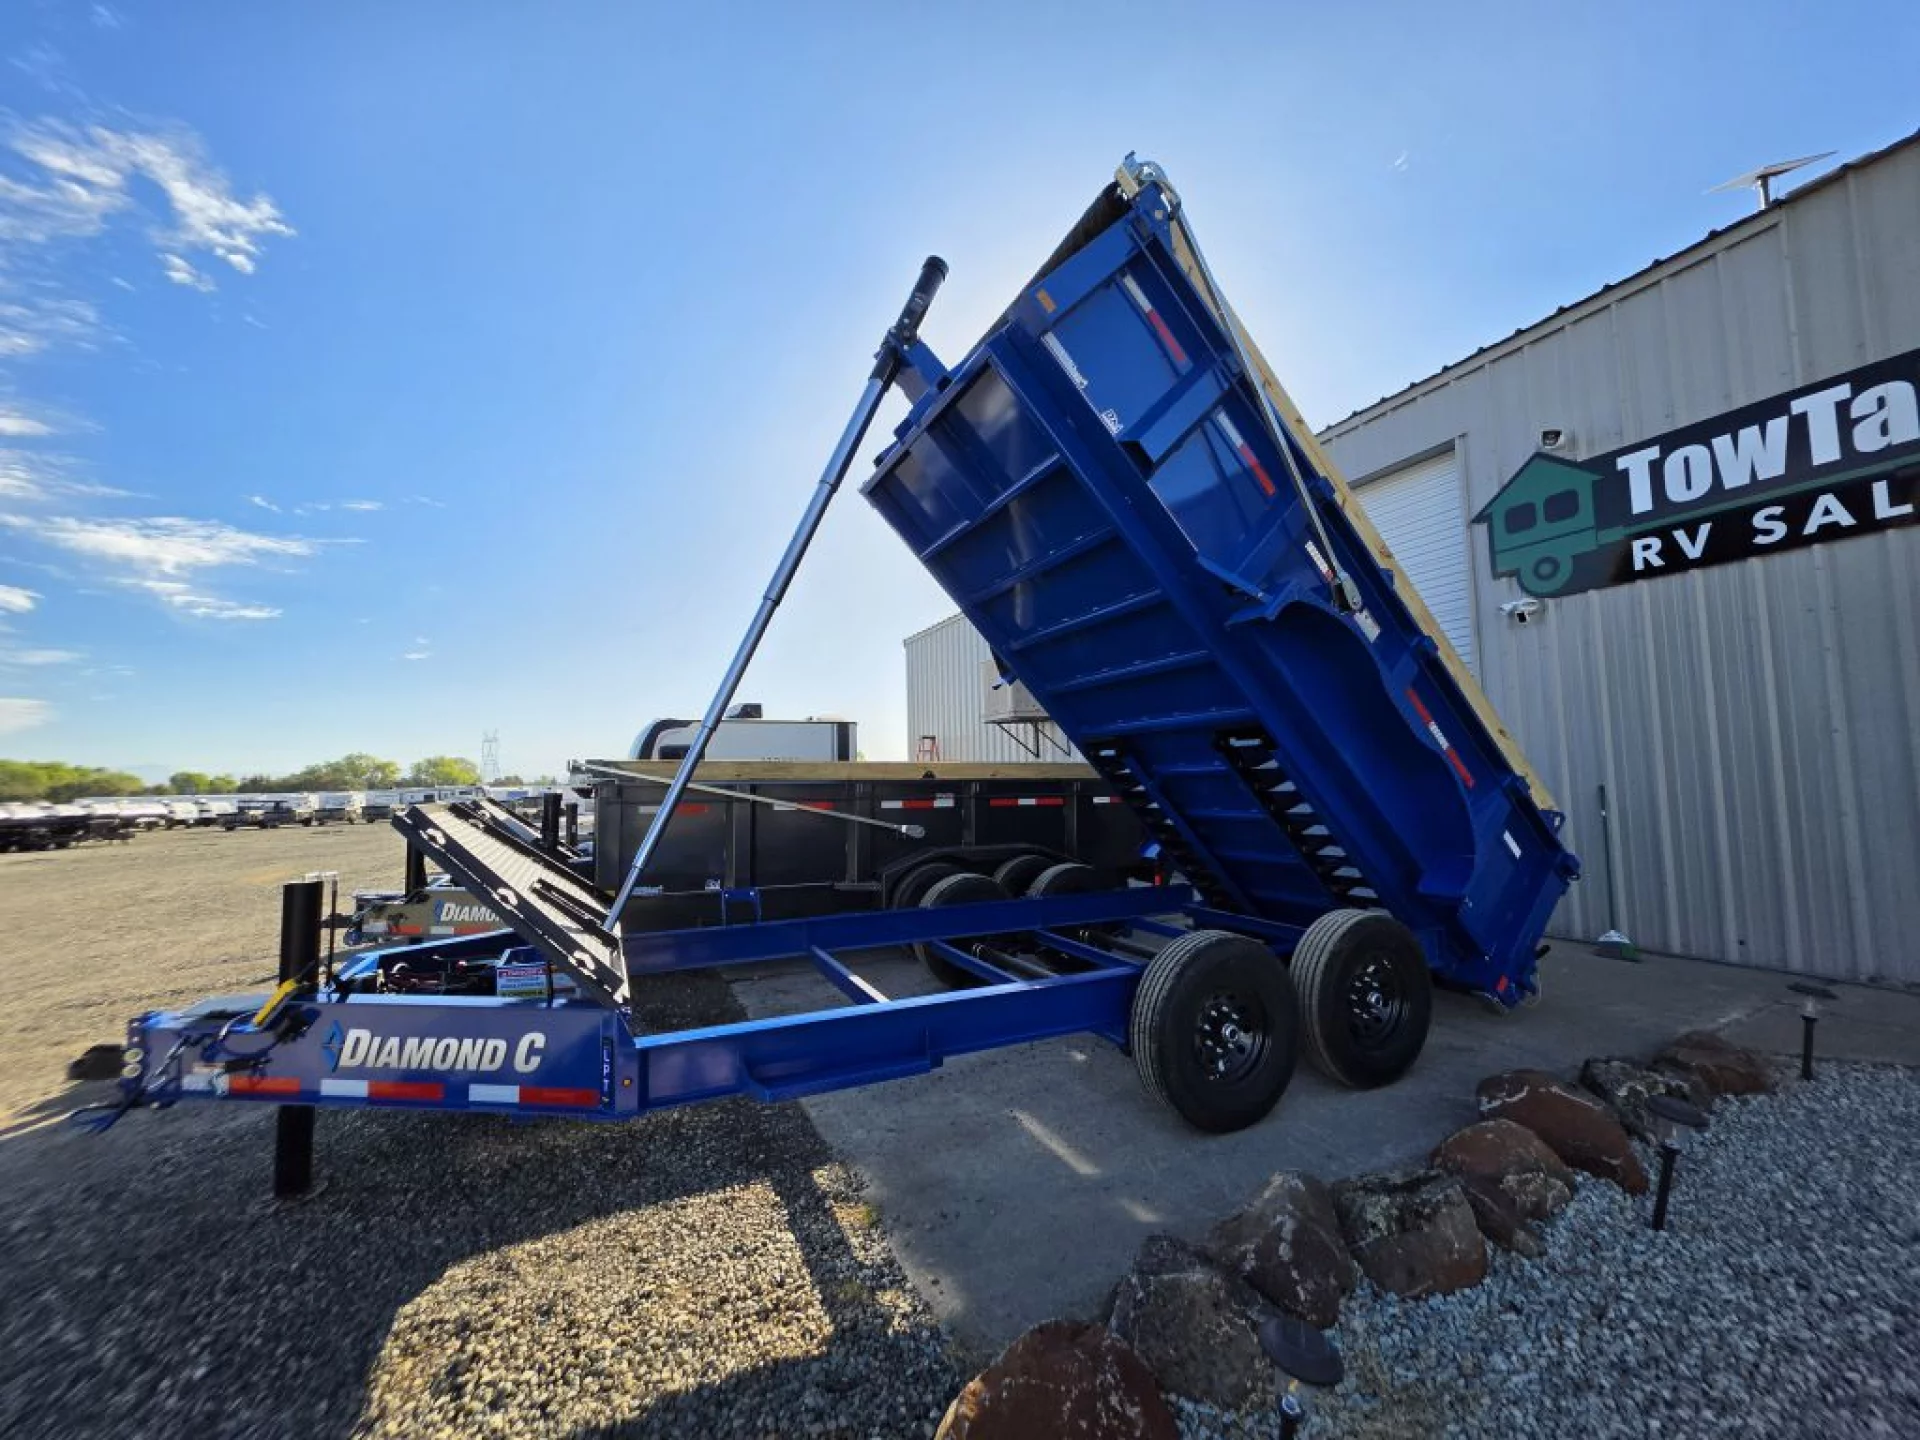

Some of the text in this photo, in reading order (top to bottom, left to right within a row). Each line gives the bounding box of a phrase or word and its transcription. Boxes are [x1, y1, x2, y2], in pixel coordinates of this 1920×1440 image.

[1632, 480, 1914, 571] RV SAL
[441, 903, 499, 921] DIAMO
[339, 1028, 546, 1073] DIAMOND C
